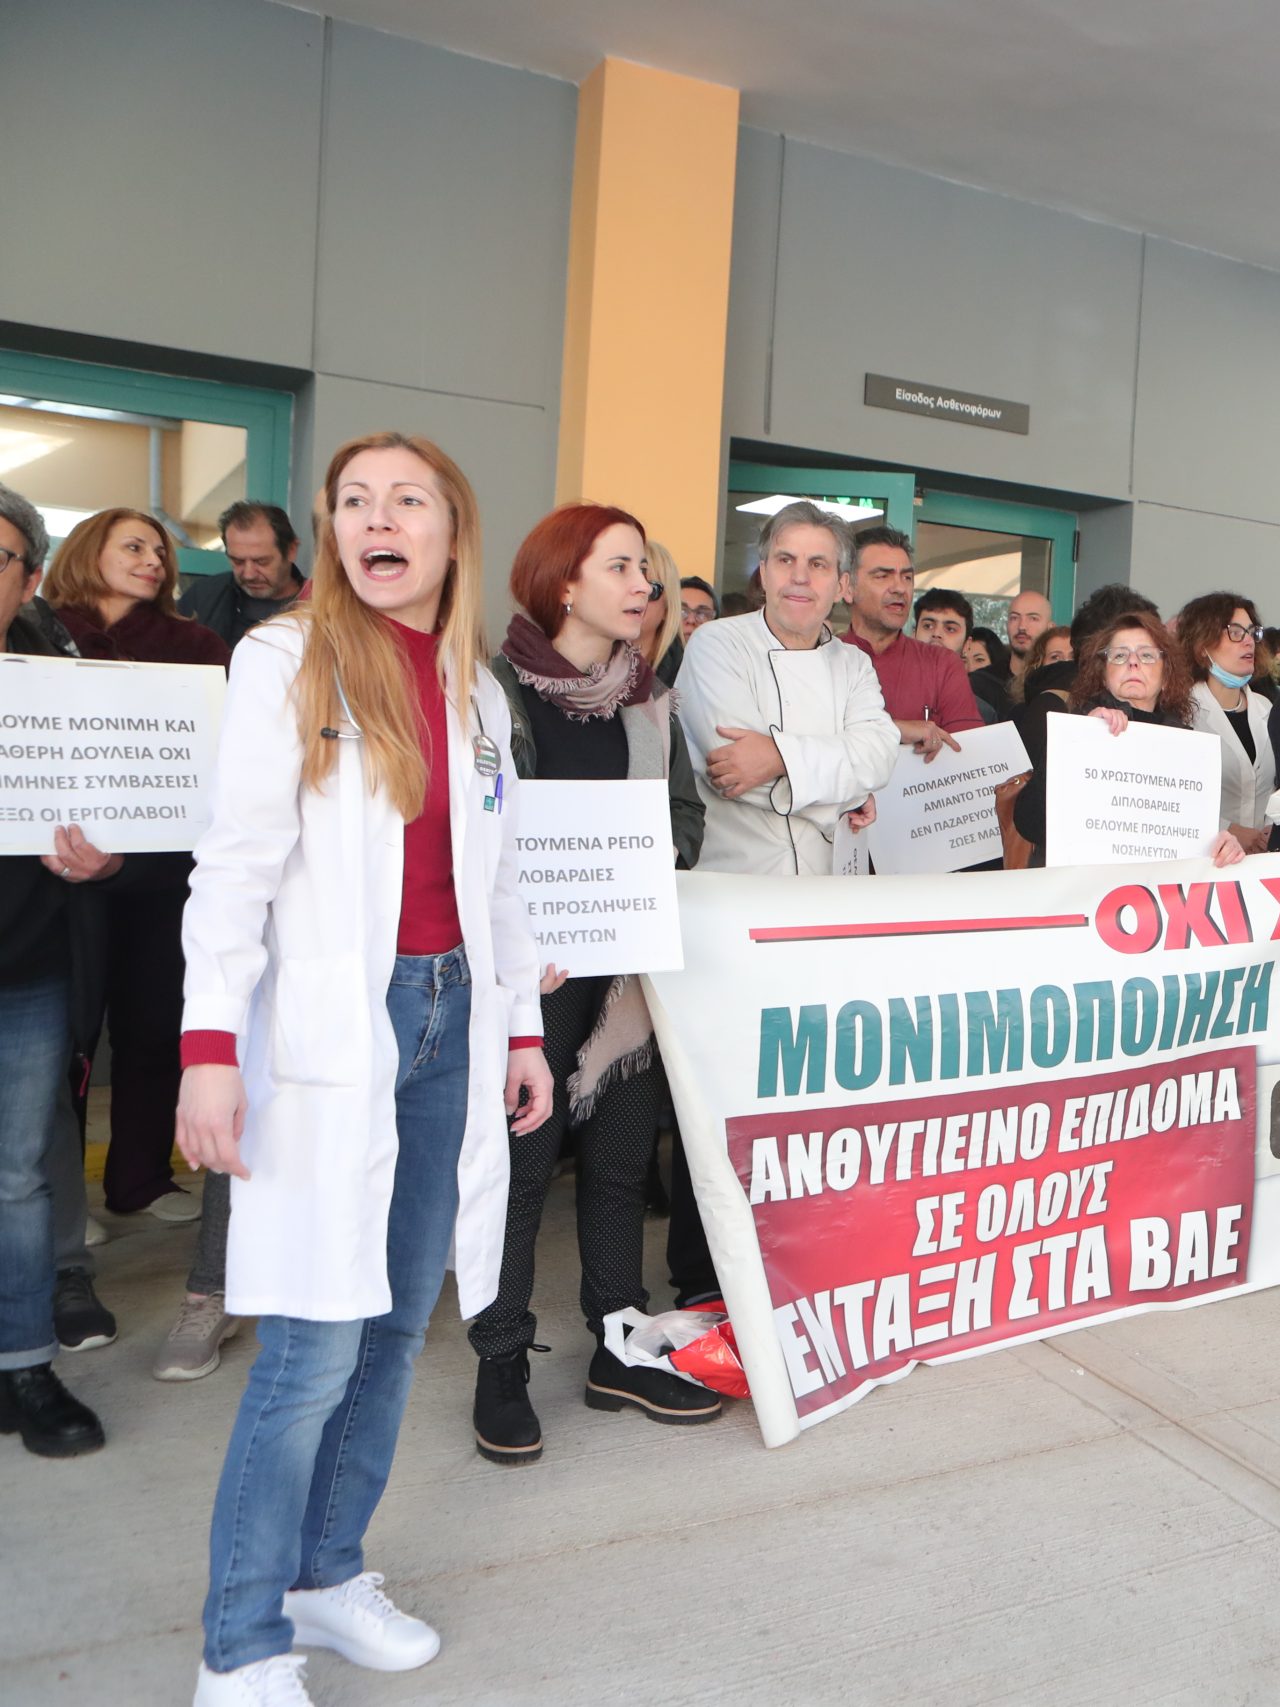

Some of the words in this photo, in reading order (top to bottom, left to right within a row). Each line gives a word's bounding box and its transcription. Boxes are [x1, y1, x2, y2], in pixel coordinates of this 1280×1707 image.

[895, 388, 935, 408] Είσοδος
[936, 396, 1002, 419] Ασθενοφόρων
[69, 717, 159, 732] ΜΟΝΙΜΗ
[165, 719, 196, 733] ΚΑΙ
[71, 746, 154, 760] ΔΟΥΛΕΙΑ
[159, 747, 191, 761] ΟΧΙ
[84, 774, 199, 789] ΣΥΜΒΑΣΕΙΣ!
[902, 770, 988, 797] ΑΠΟΜΑΚΡΥΝΕΤΕ
[988, 762, 1010, 775] ΤΟΝ
[1084, 768, 1099, 779] 50
[1100, 769, 1177, 789] ΧΡΩΣΤΟΥΜΕΝΑ
[1179, 778, 1204, 792] ΡΕΠΟ
[923, 791, 974, 813] ΑΜΙΑΝΤΟ
[977, 785, 997, 798] ΤΩΡ
[1111, 796, 1181, 814] ΔΙΠΛΟΒΑΡΔΙΕΣ
[40, 807, 62, 822] ΟΙ
[69, 805, 187, 822] ΕΡΓΟΛΑΒΟΙ!
[910, 823, 933, 840] ΔΕΝ
[949, 833, 976, 849] ΖΩΕΣ
[978, 826, 1001, 841] ΜΑΣ
[1085, 818, 1139, 833] ΘΕΛΟΥΜΕ
[1141, 823, 1200, 840] ΠΡΟΣΛΗΨΕΙΣ
[608, 836, 654, 849] ΡΕΠΟ
[1112, 844, 1178, 859] ΝΟΣΗΛΕΥΤΩΝ
[518, 868, 615, 883] ΛΟΒΑΡΔΙΕΣ
[543, 897, 657, 915] ΠΡΟΣΛΗΨΕΙΣ
[1095, 879, 1253, 954] ΟΧΙ
[757, 961, 1275, 1098] ΜΟΝΙΜΟΠΟΙΗΣΗ
[750, 1102, 1051, 1205] ΑΝΘΥΓΙΕΙΝΟ
[1058, 1067, 1242, 1153] ΕΠΙΔΟΜΑ
[911, 1190, 965, 1257] ΣΕ
[975, 1160, 1114, 1244] ΟΛΟΥΣ
[777, 1252, 997, 1398] ΕΝΤΑΞΗ
[1008, 1223, 1112, 1321] ΣΤΑ
[1129, 1203, 1243, 1292] ΒΑΕ
